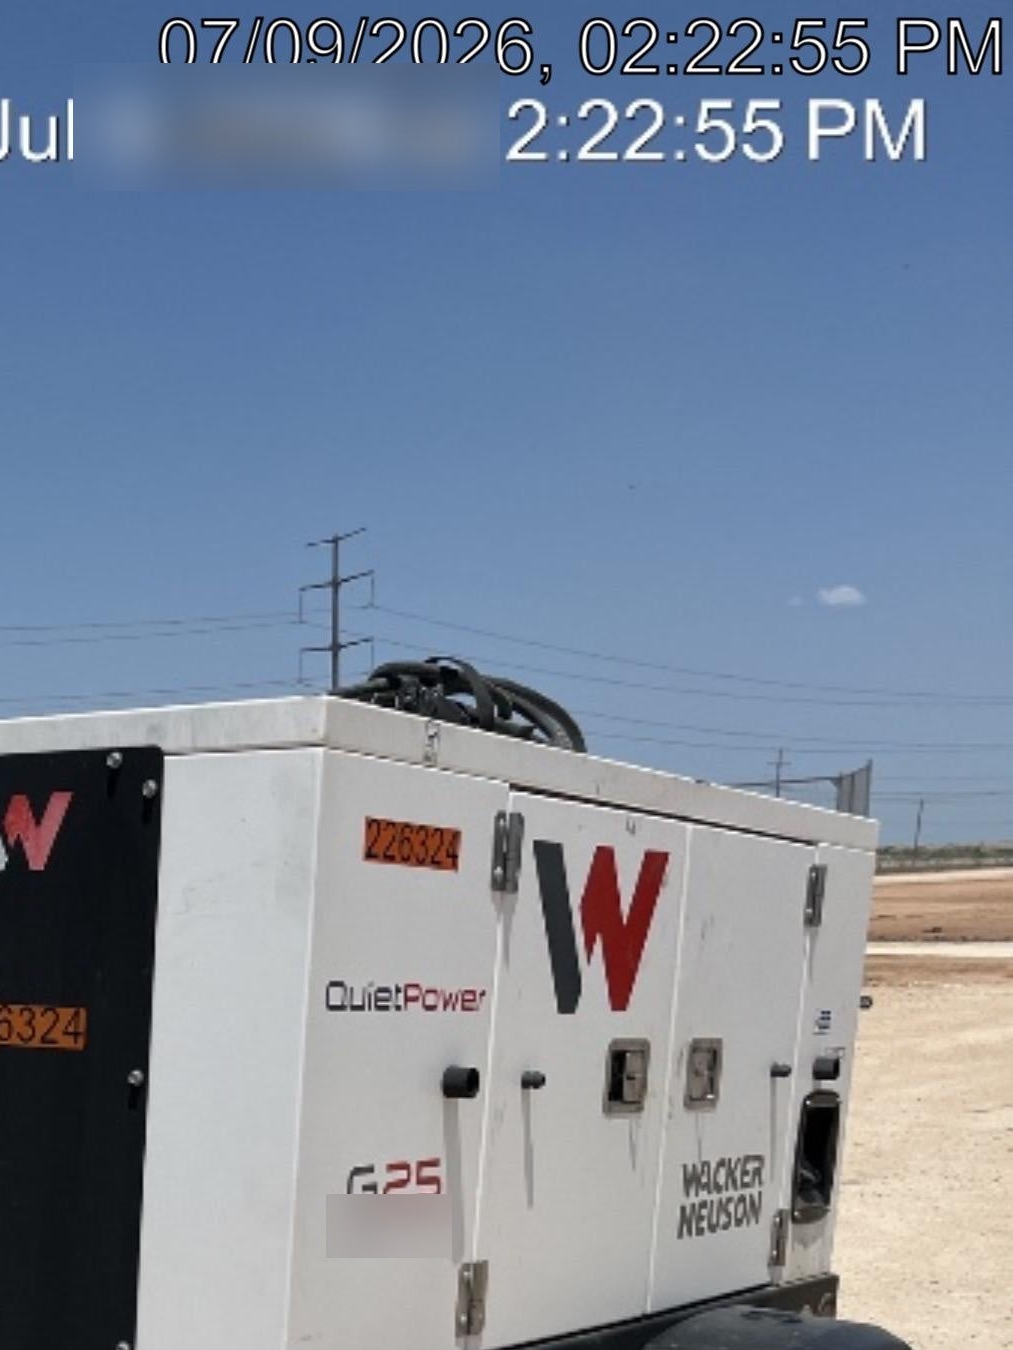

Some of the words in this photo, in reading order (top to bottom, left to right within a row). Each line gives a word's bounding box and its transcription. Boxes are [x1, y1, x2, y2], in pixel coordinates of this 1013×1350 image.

[365, 817, 459, 869] 226324
[325, 980, 487, 1012] QuietPower
[346, 1157, 442, 1195] G25
[682, 1154, 765, 1198] WACKER
[676, 1190, 762, 1240] NEUSON
